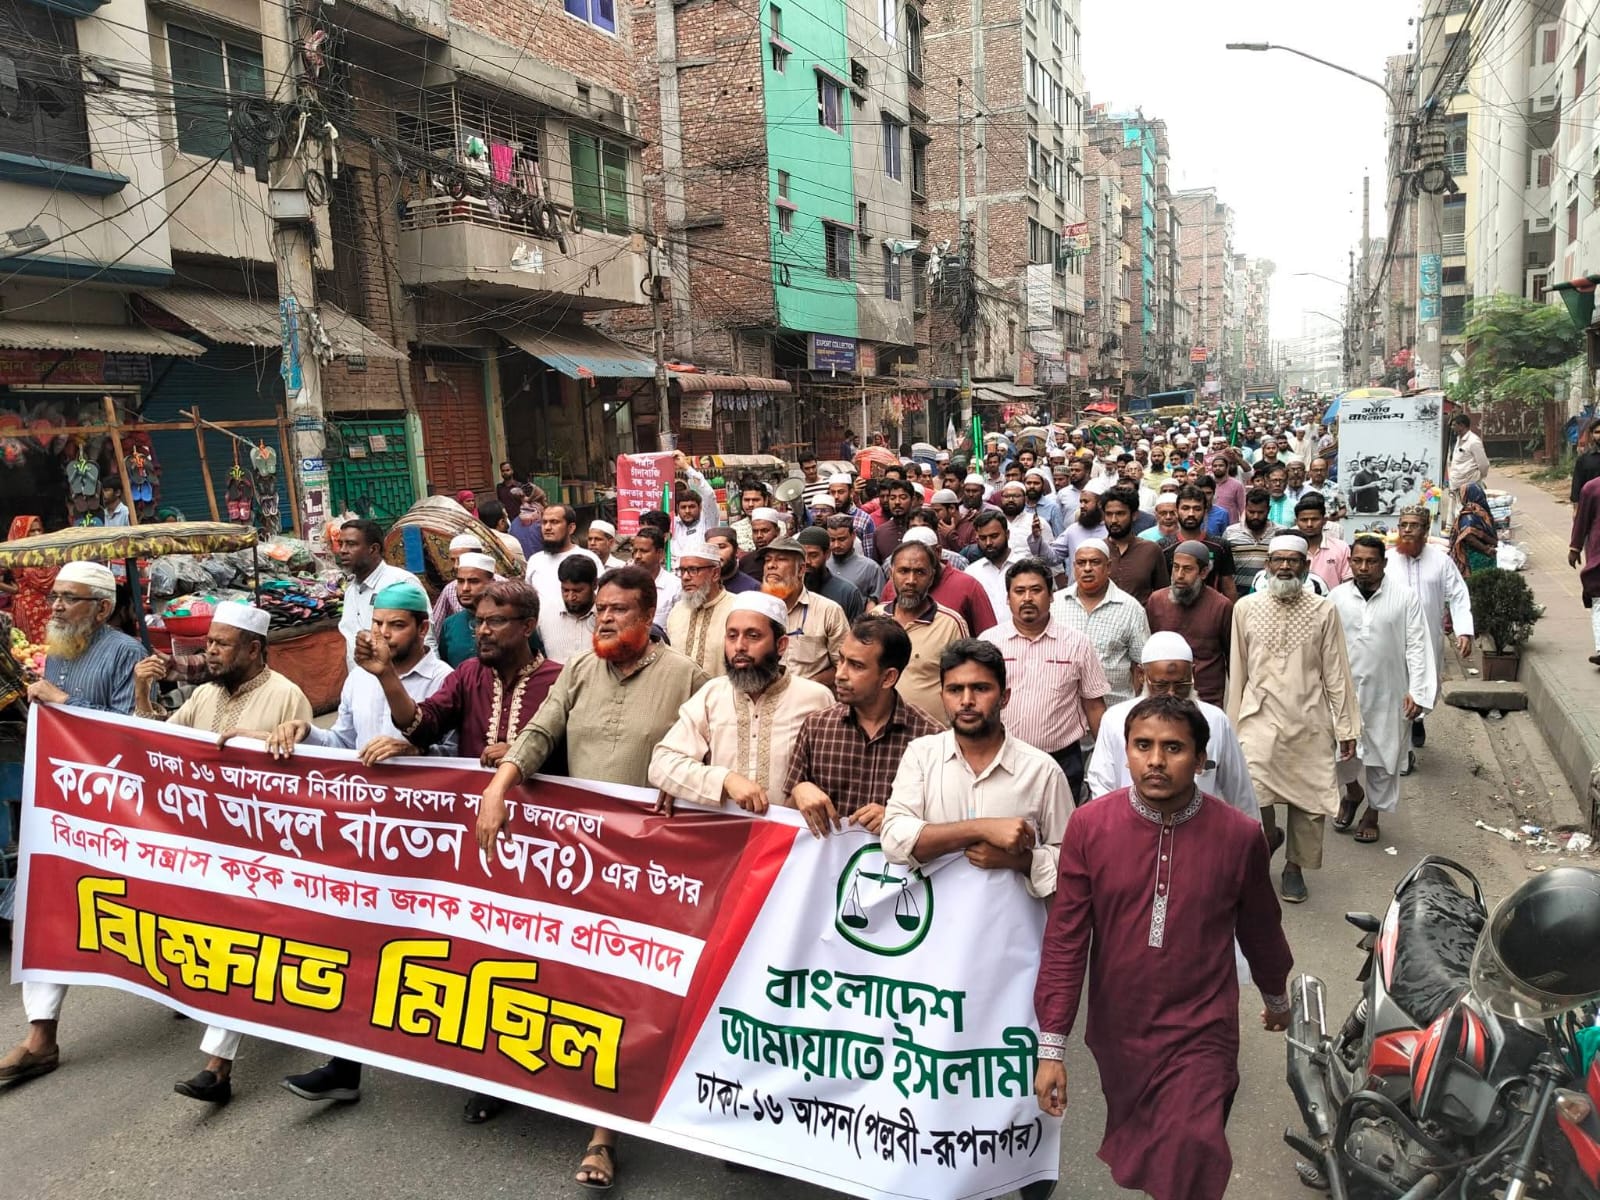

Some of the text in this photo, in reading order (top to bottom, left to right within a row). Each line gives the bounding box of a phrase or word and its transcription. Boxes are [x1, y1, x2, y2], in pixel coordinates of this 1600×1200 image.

[48, 754, 145, 816] কর্নেল
[158, 783, 208, 828] এম
[215, 793, 327, 858] আব্দুল
[335, 808, 468, 872] বাতেন
[601, 862, 642, 892] এর
[647, 860, 704, 907] উপর
[146, 751, 183, 776] ঢাকা
[190, 762, 215, 782] ১৬
[219, 766, 301, 797] আসনের
[306, 770, 388, 803] নির্বাচিত
[393, 786, 456, 813] সংসদ
[522, 803, 605, 838] জননেতা
[51, 814, 685, 977] বিএনপি সন্ত্রাস কর্তৃক ন্যাক্কার জনক হামলার প্রতিবাদে
[77, 876, 625, 1093] বিক্ষোভ মিছিল
[765, 965, 966, 1033] বাংলাদেশ
[695, 1071, 784, 1125] ঢাকা-১৬
[719, 1006, 1038, 1100] জামায়াতে ইসলামী
